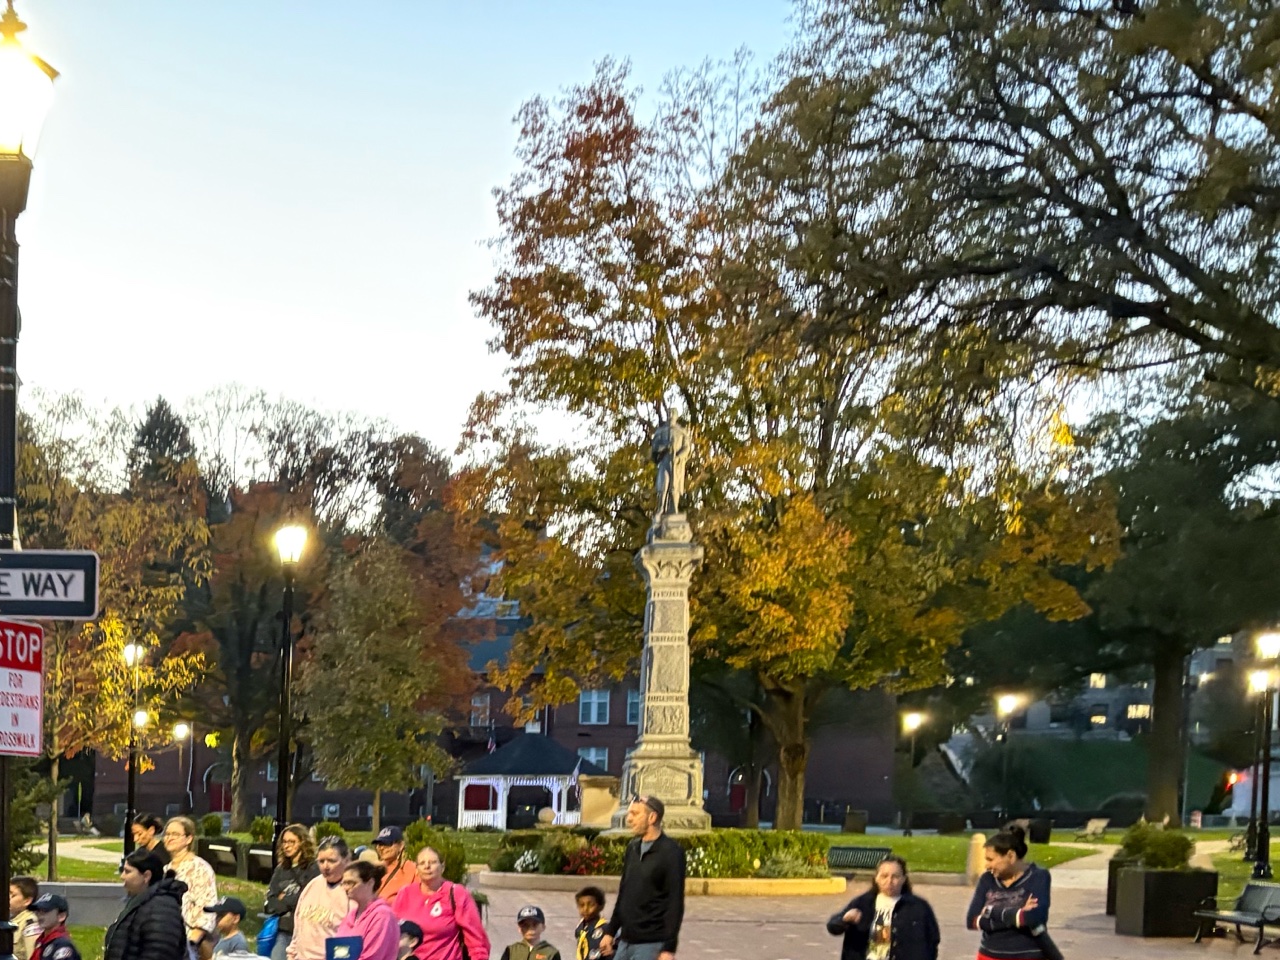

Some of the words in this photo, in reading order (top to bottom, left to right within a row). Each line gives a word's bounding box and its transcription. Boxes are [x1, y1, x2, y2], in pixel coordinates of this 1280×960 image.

[22, 572, 75, 598] WAY
[8, 672, 23, 688] FOR
[11, 712, 19, 727] IN
